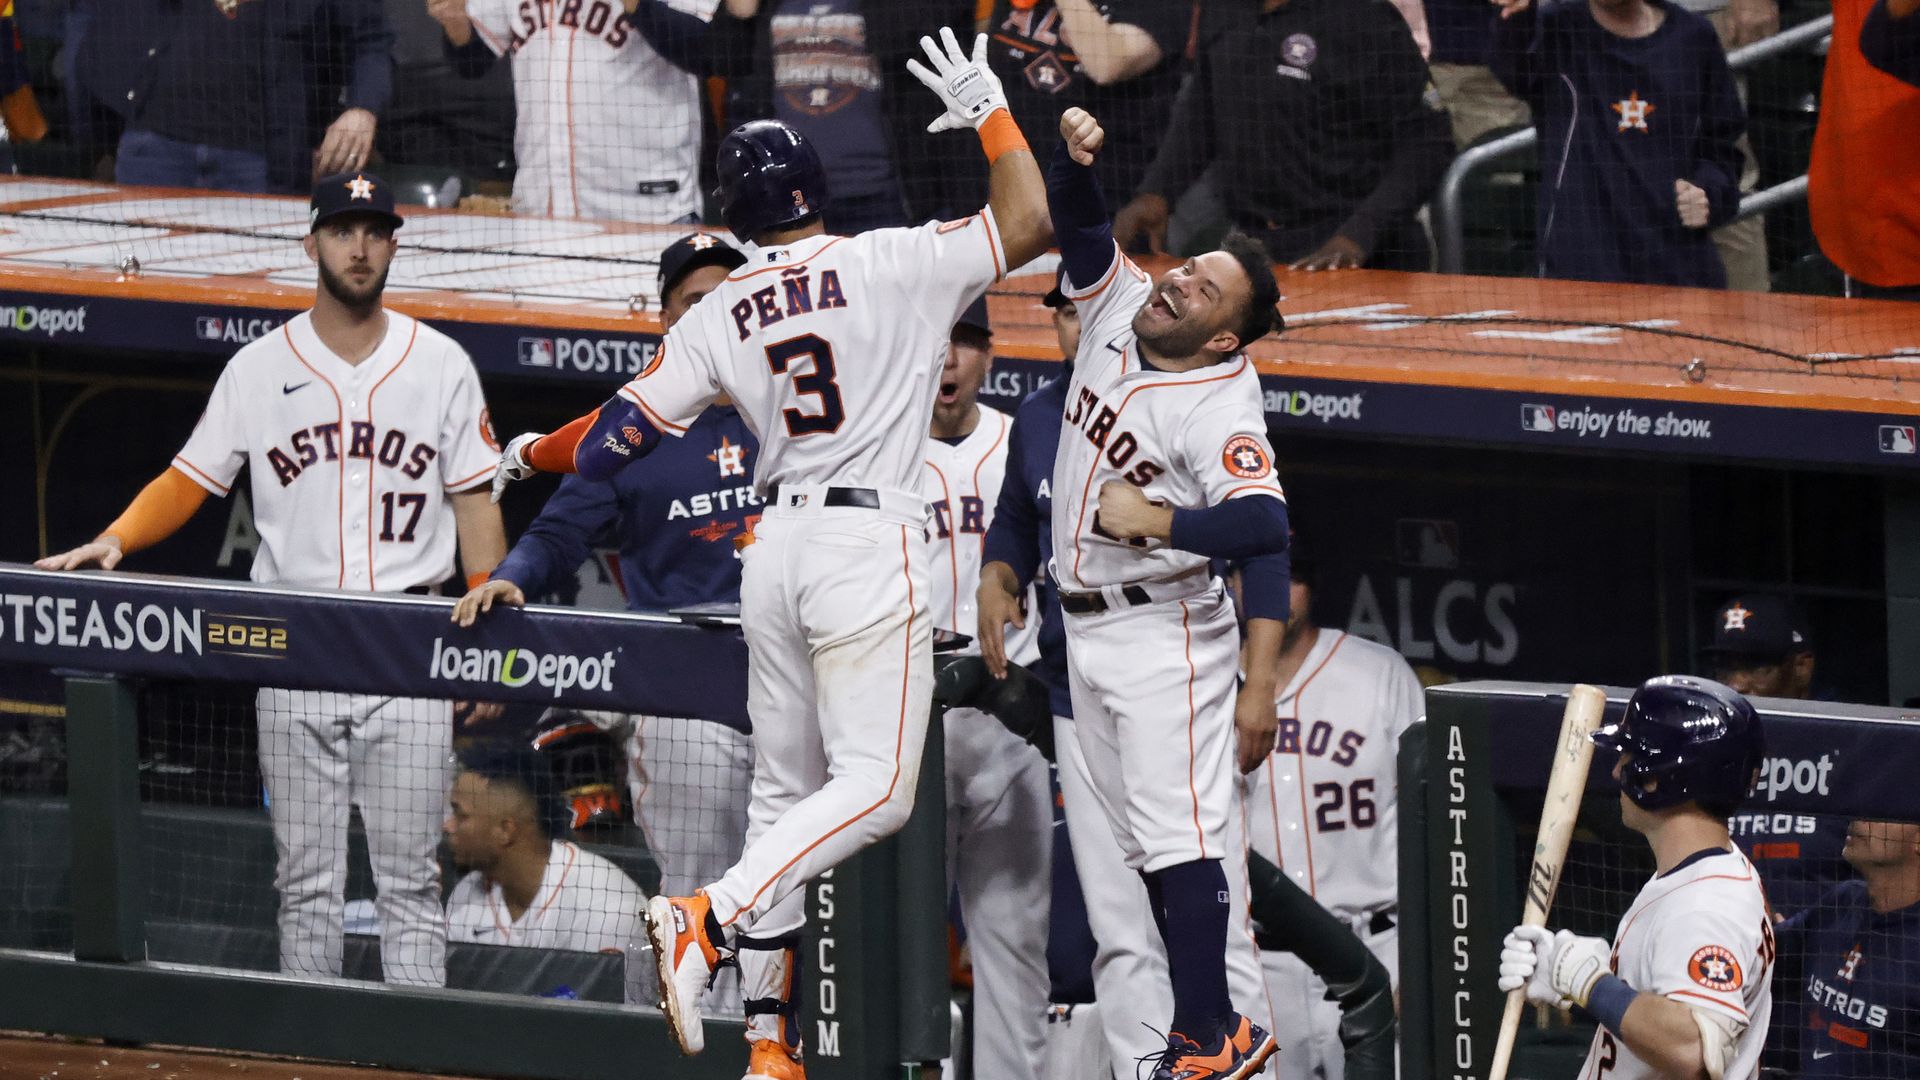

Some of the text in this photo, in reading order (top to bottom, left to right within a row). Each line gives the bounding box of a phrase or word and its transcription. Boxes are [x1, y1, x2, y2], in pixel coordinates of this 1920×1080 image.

[792, 190, 804, 206] 3
[0, 306, 87, 336] nDepot
[731, 265, 848, 343] PEÑA
[763, 332, 846, 438] 3
[979, 371, 1021, 397] LCS
[1557, 406, 1712, 438] enjoy the show.
[266, 421, 438, 488] ASTROS
[379, 491, 427, 543] 17
[667, 485, 768, 521] ASTR
[923, 496, 986, 544] TR
[0, 593, 288, 657] TSEASON 2022
[1346, 573, 1520, 666] ALCS
[429, 637, 616, 699] loanDepot
[1313, 778, 1378, 834] 26
[1446, 725, 1476, 1080] ASTROS.CO
[816, 868, 841, 1057] S.COM
